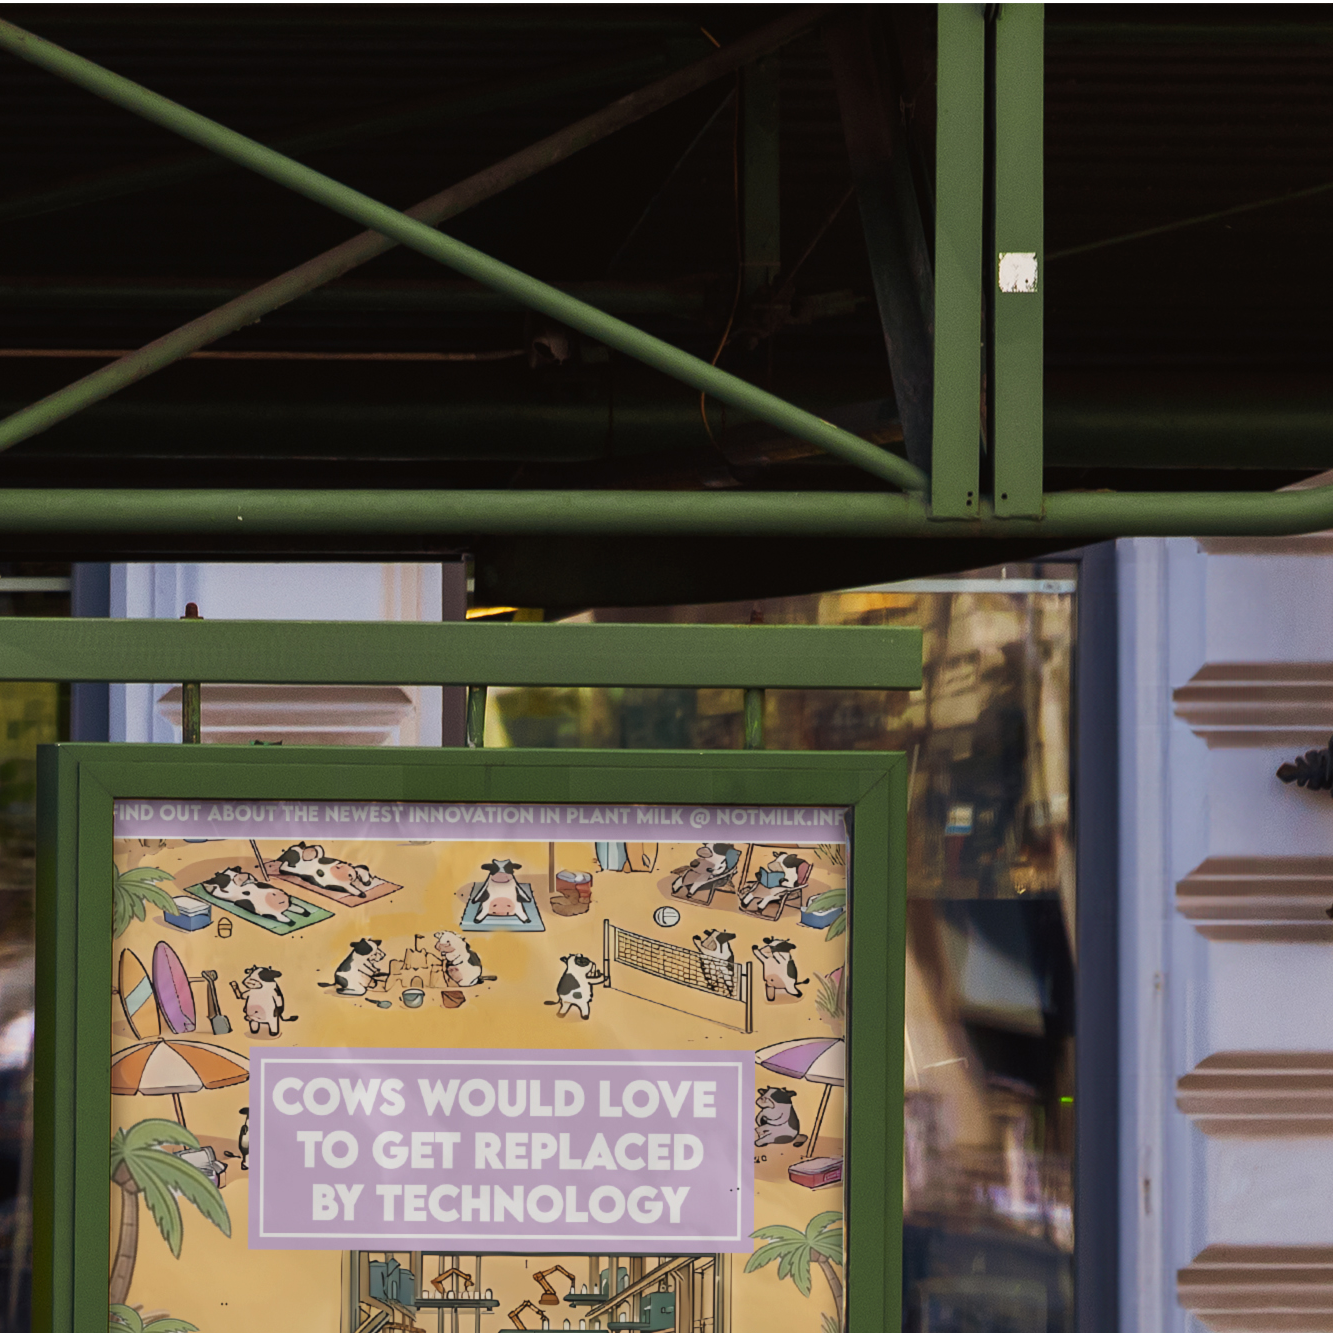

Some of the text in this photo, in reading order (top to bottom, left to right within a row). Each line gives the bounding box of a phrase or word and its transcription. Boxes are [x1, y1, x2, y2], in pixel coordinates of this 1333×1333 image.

[159, 803, 202, 822] OUT
[207, 804, 277, 822] ABOUT
[282, 805, 319, 822] THE
[325, 805, 404, 823] NEWEST
[408, 806, 534, 823] INNOVATION
[540, 807, 560, 824] IN
[566, 807, 633, 824] PLANT
[636, 808, 684, 825] MILK
[689, 808, 711, 829] @
[272, 1077, 717, 1119] COWS WOULD LOVE
[297, 1131, 704, 1171] TO GET REPLACED
[312, 1184, 691, 1224] BY TECHNOLOGY
